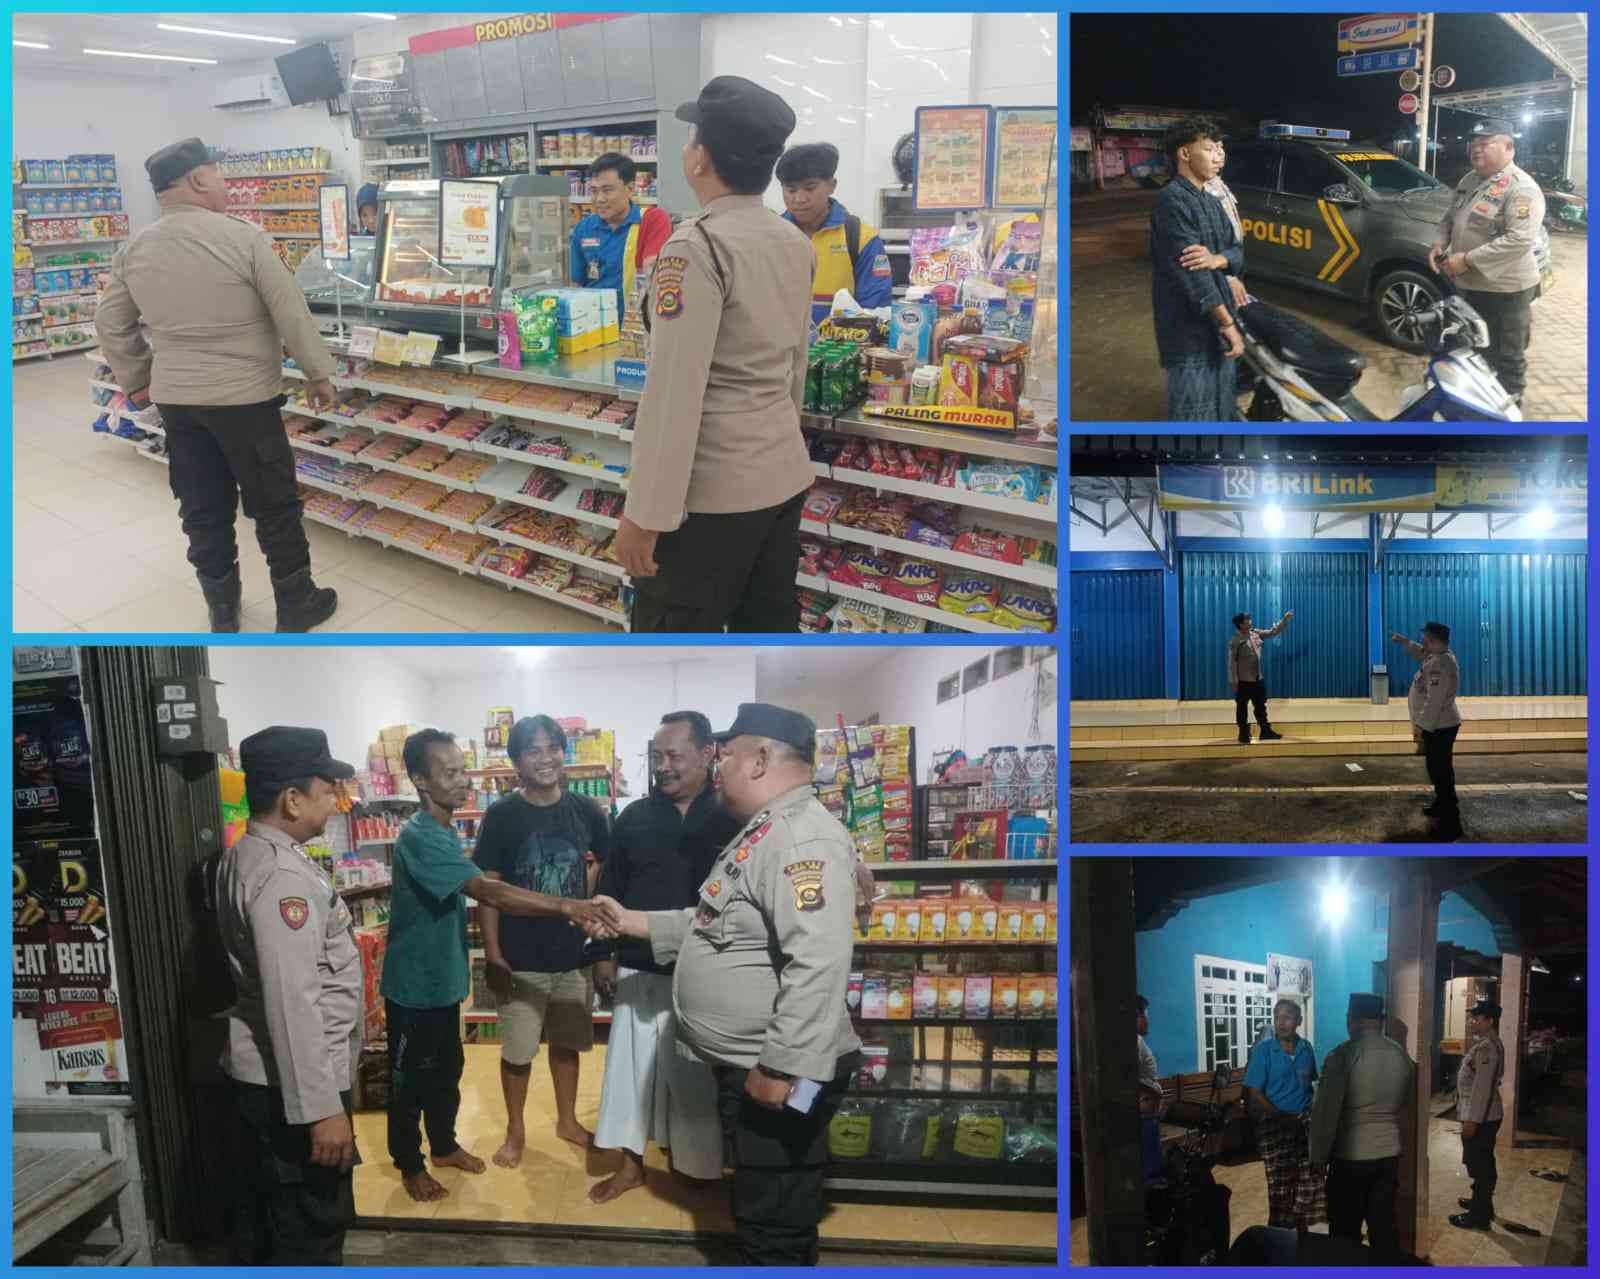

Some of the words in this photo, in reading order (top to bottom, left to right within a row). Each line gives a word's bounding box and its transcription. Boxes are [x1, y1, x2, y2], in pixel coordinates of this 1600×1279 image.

[475, 12, 553, 42] PROMOSI
[1241, 218, 1313, 250] POLISI
[884, 405, 942, 422] PALING
[943, 410, 1009, 426] MURAH
[1261, 470, 1374, 497] BRILink
[60, 861, 88, 893] D
[56, 942, 107, 974] BEAT
[56, 1048, 106, 1071] Kansas
